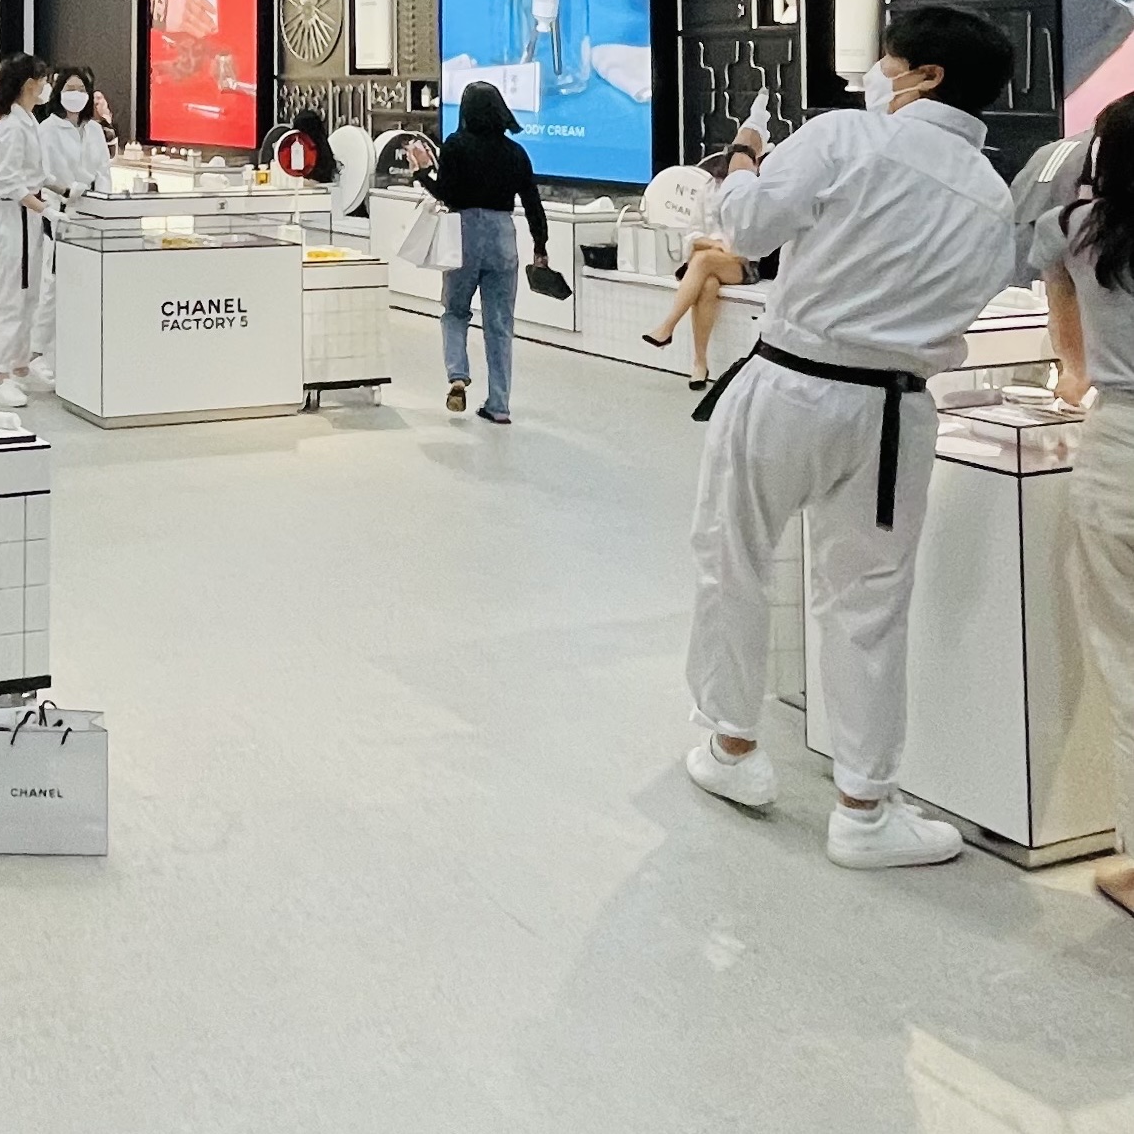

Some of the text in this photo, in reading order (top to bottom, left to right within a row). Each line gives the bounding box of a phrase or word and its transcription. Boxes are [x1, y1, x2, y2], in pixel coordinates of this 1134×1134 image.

[521, 123, 585, 138] ODY CREAM
[161, 297, 248, 317] CHANEL
[161, 315, 249, 332] FACTORY 5
[10, 787, 64, 799] CHANEL
